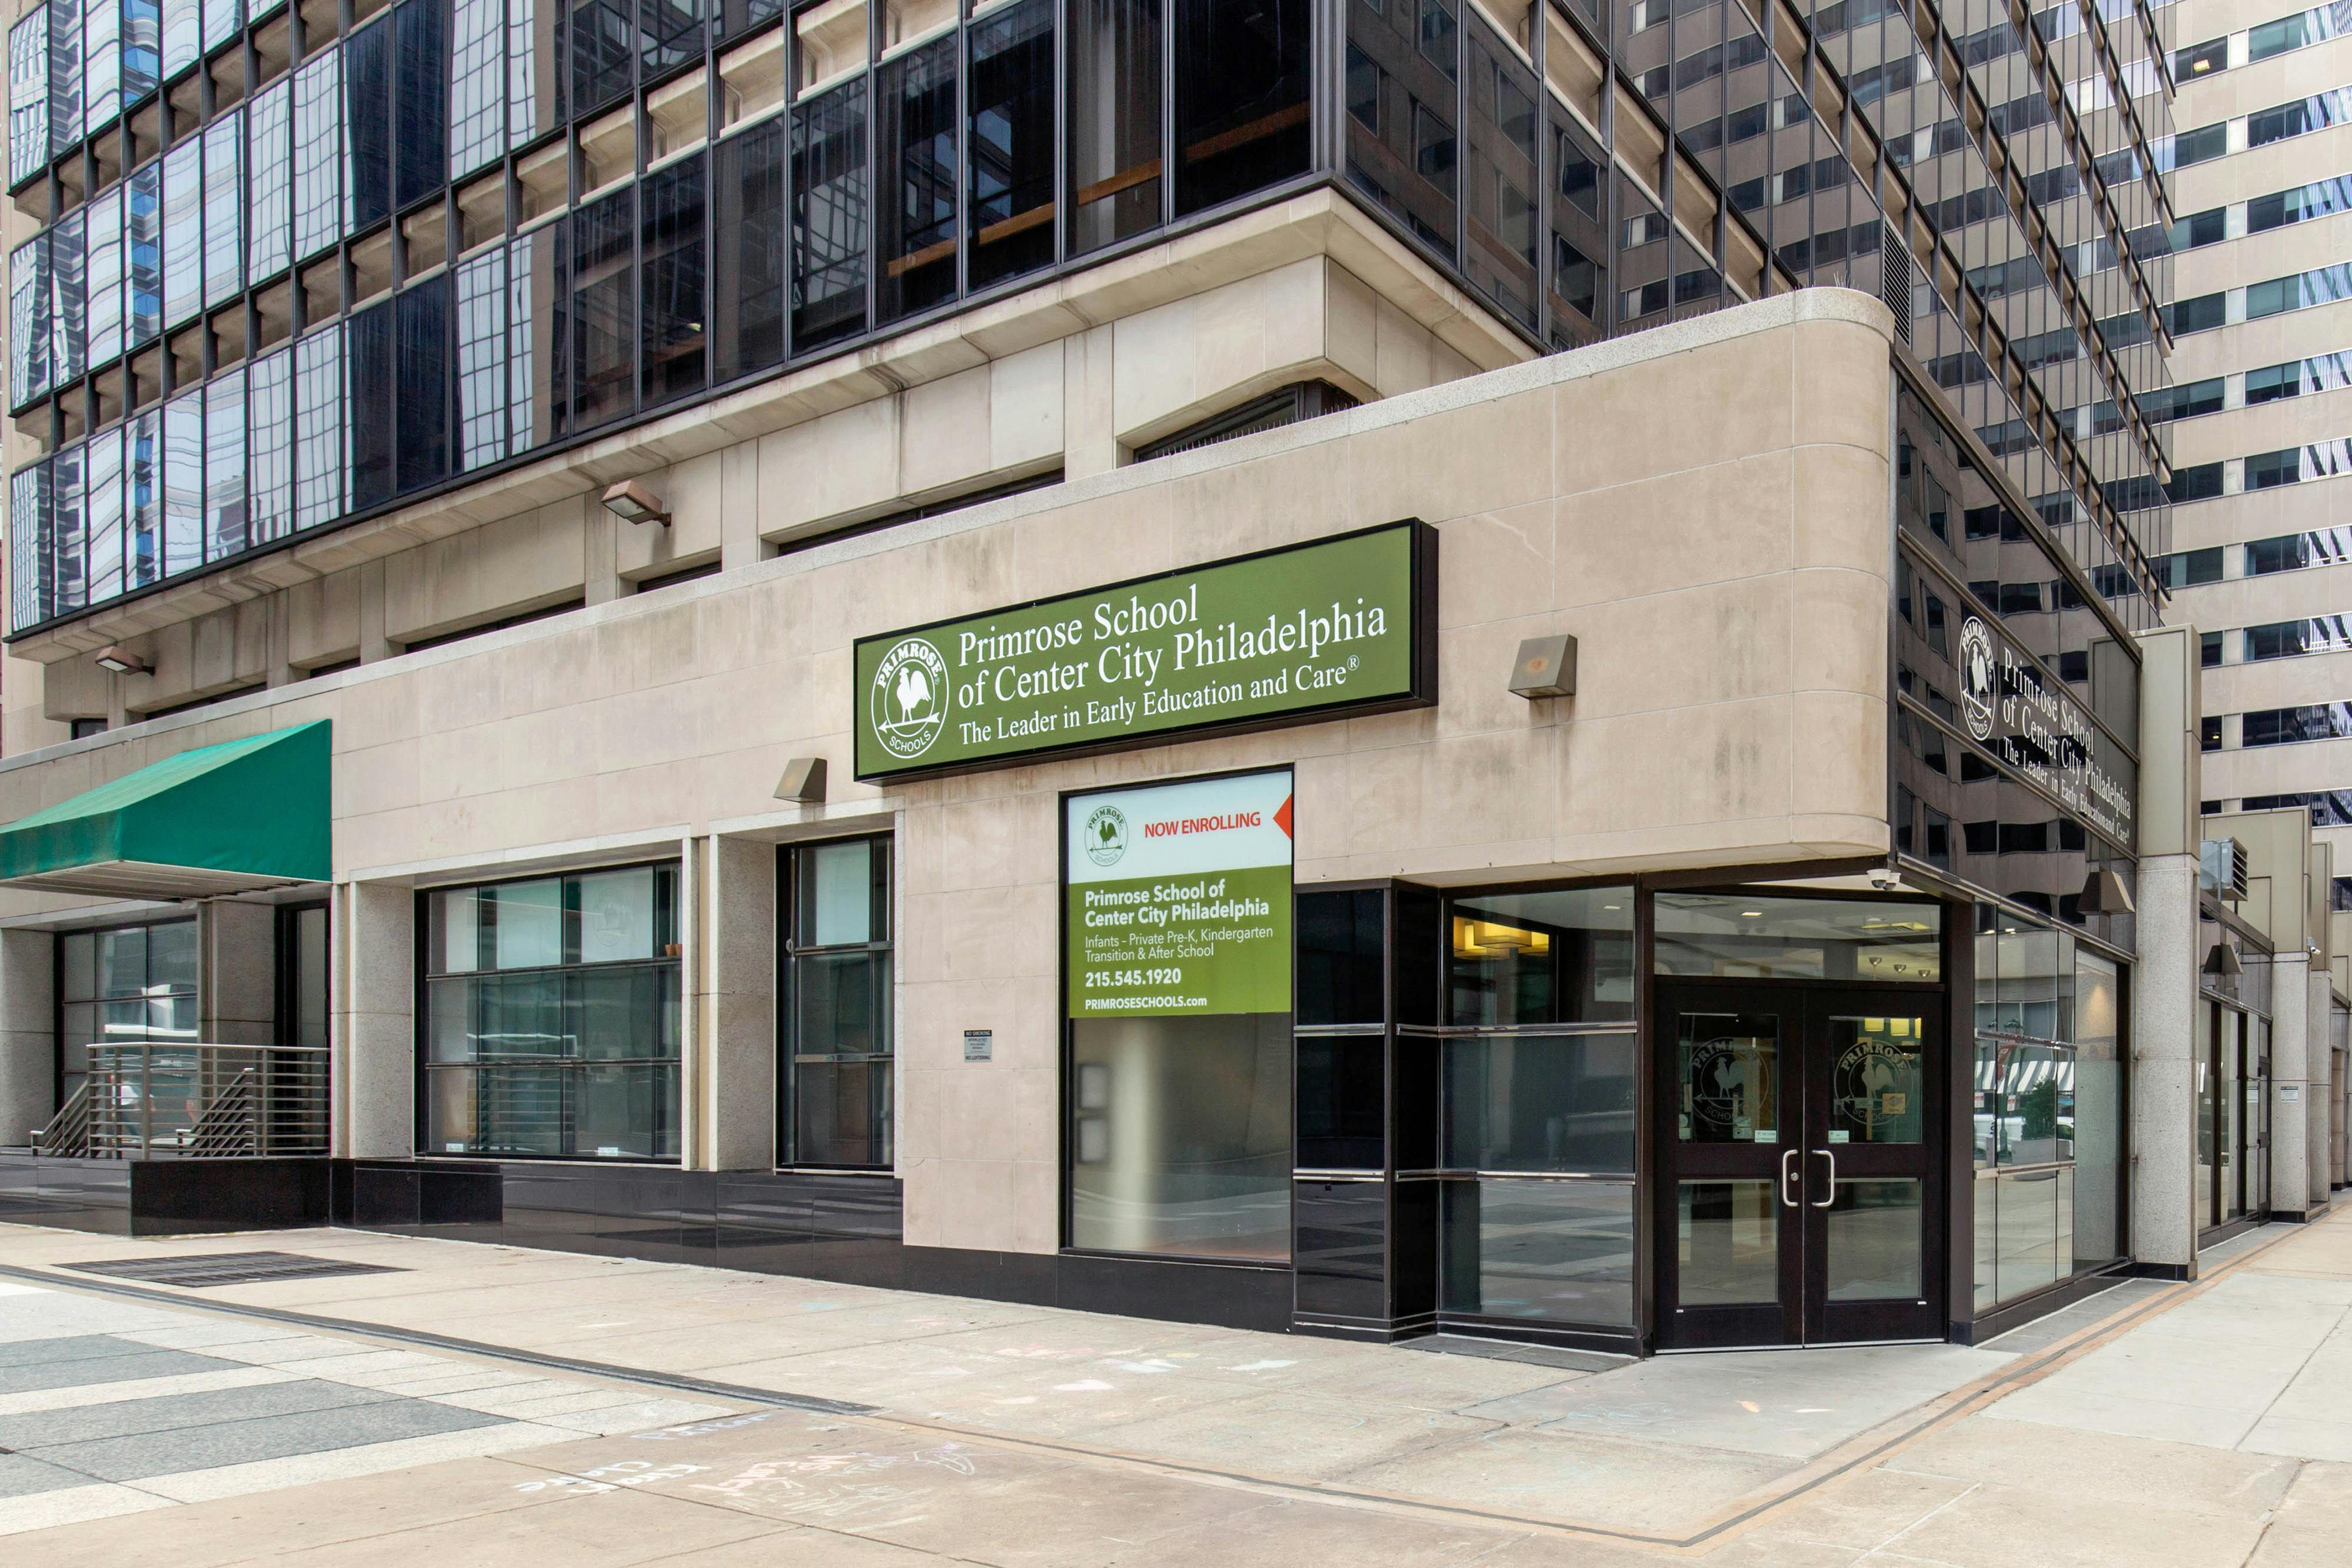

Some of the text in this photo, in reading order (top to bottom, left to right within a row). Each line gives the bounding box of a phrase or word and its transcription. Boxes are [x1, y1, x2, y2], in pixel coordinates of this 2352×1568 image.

[958, 583, 1198, 667] Primrose School
[958, 598, 1388, 709] of Center City Philadelphia
[959, 721, 991, 745] The
[997, 710, 1058, 739] Leader
[1063, 706, 1081, 728] in
[1086, 695, 1137, 726] Early
[1142, 680, 1243, 716] Education
[1250, 668, 1288, 699] and
[2003, 646, 2094, 756] Primrose School
[1967, 707, 1988, 735] SCHOOLS
[889, 730, 931, 753] SCHOOLS
[2003, 694, 2131, 820] of Center City Philadelphia
[2003, 736, 2019, 766] The
[2022, 750, 2048, 786] Leader
[2051, 771, 2058, 794] in
[2061, 778, 2078, 812] Early
[1143, 811, 1261, 838] NOW ENROLLING
[1085, 878, 1225, 907] Primrose School of
[1085, 897, 1269, 927] Center City Philadelphia
[1085, 934, 1119, 948] Infants
[1129, 932, 1164, 946] Private
[1167, 930, 1199, 945] Pre-K,
[1201, 927, 1273, 944] Kindergarten
[1085, 942, 1214, 962] Transition & After School
[1085, 968, 1182, 987] 215.545.1920
[1085, 995, 1207, 1010] PRIMROSESCHOOLS.com
[1840, 1043, 1907, 1071] PRIMROSE
